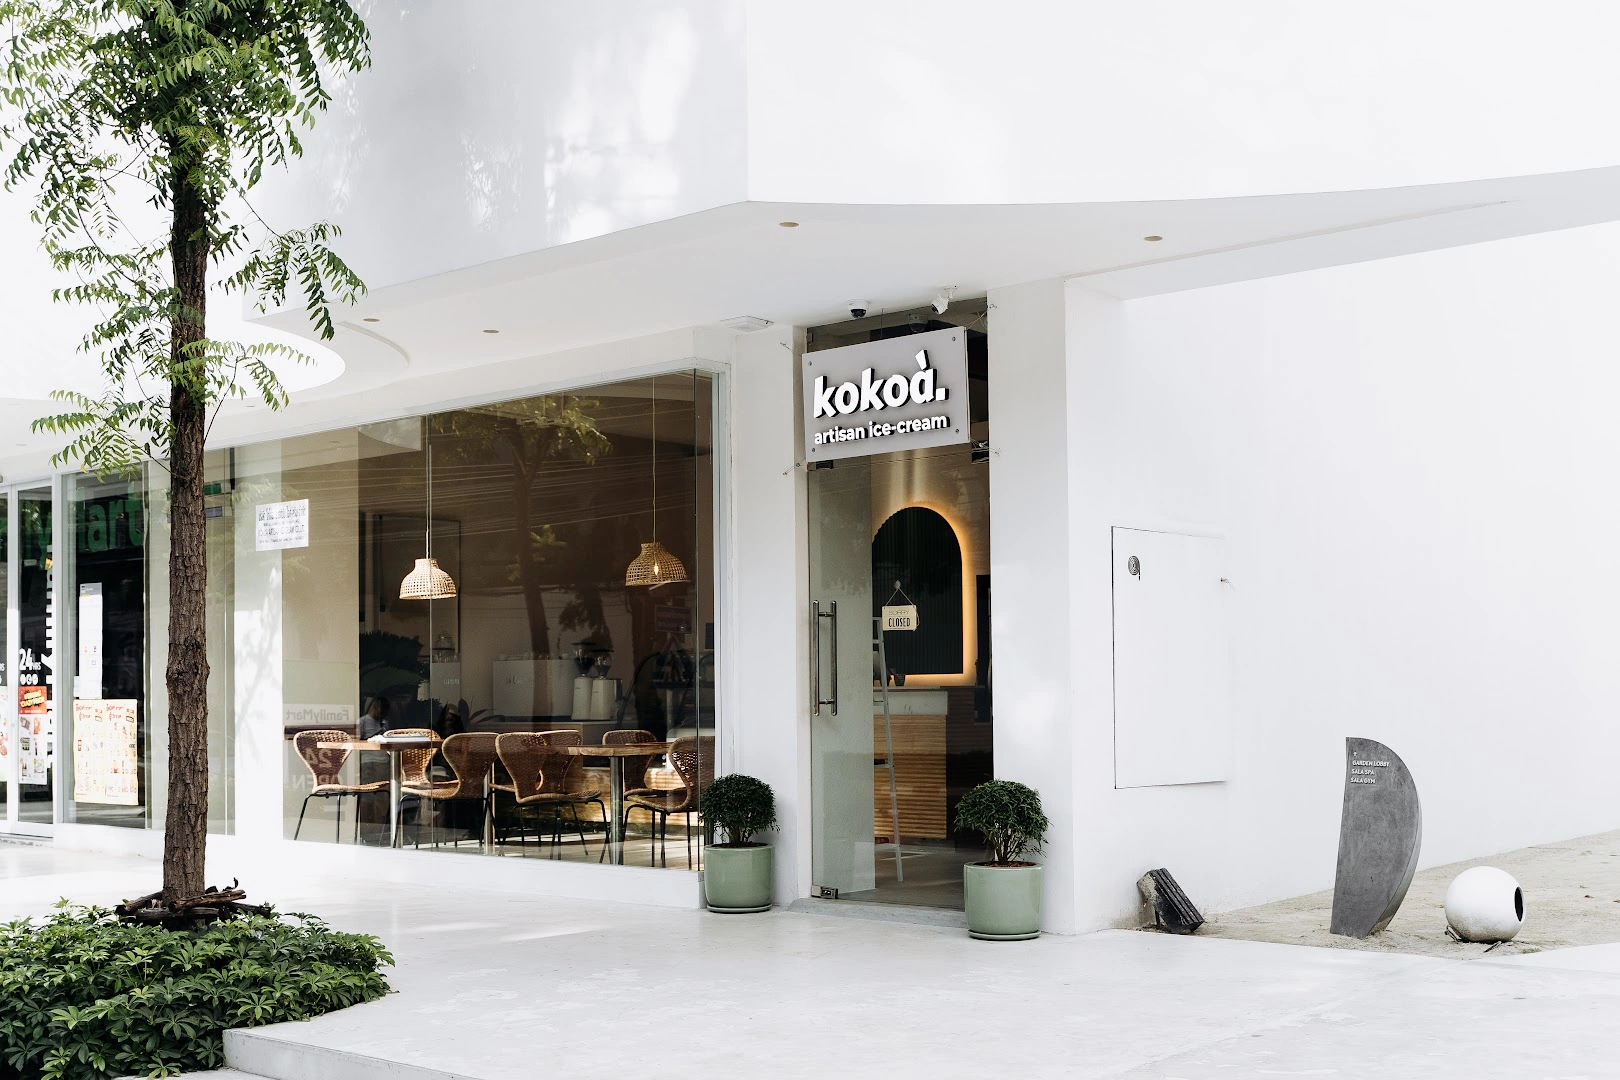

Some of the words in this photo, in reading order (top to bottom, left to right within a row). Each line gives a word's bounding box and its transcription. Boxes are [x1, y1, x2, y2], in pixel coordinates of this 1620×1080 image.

[814, 426, 866, 445] artisan
[868, 415, 949, 438] ice-cream
[889, 617, 910, 628] CLOSED
